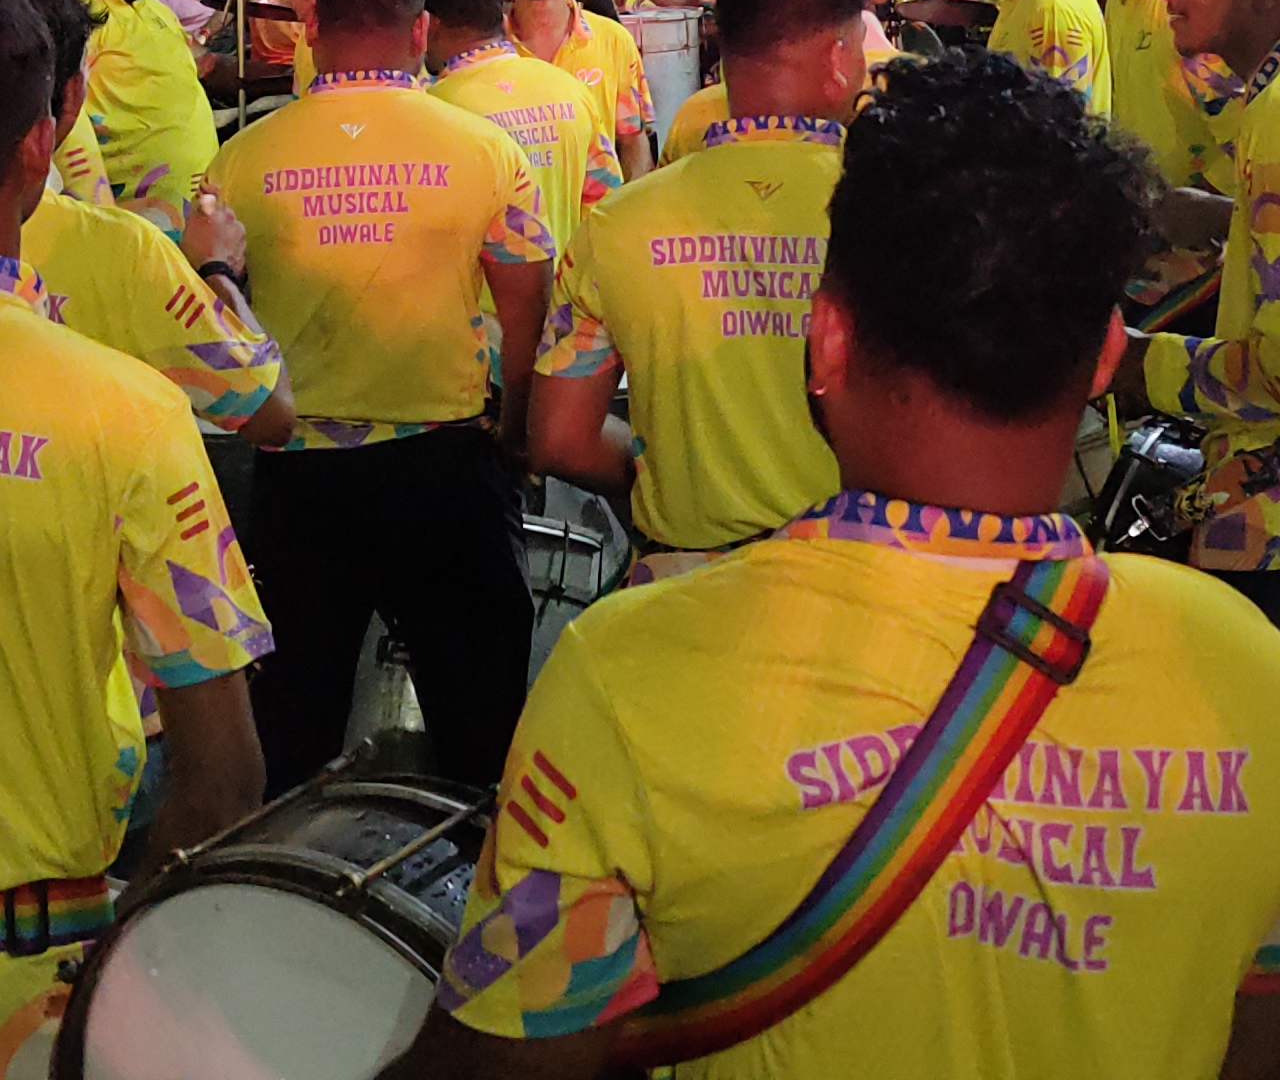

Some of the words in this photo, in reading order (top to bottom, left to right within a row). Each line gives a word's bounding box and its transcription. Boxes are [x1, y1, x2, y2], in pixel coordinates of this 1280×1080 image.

[508, 124, 560, 147] USICAL
[263, 162, 452, 196] SIDDHIVINAYAK
[302, 190, 410, 219] MUSICAL
[318, 221, 396, 247] DIWALE
[650, 234, 830, 267] SIDDHIVINA
[700, 269, 822, 300] MUSICA
